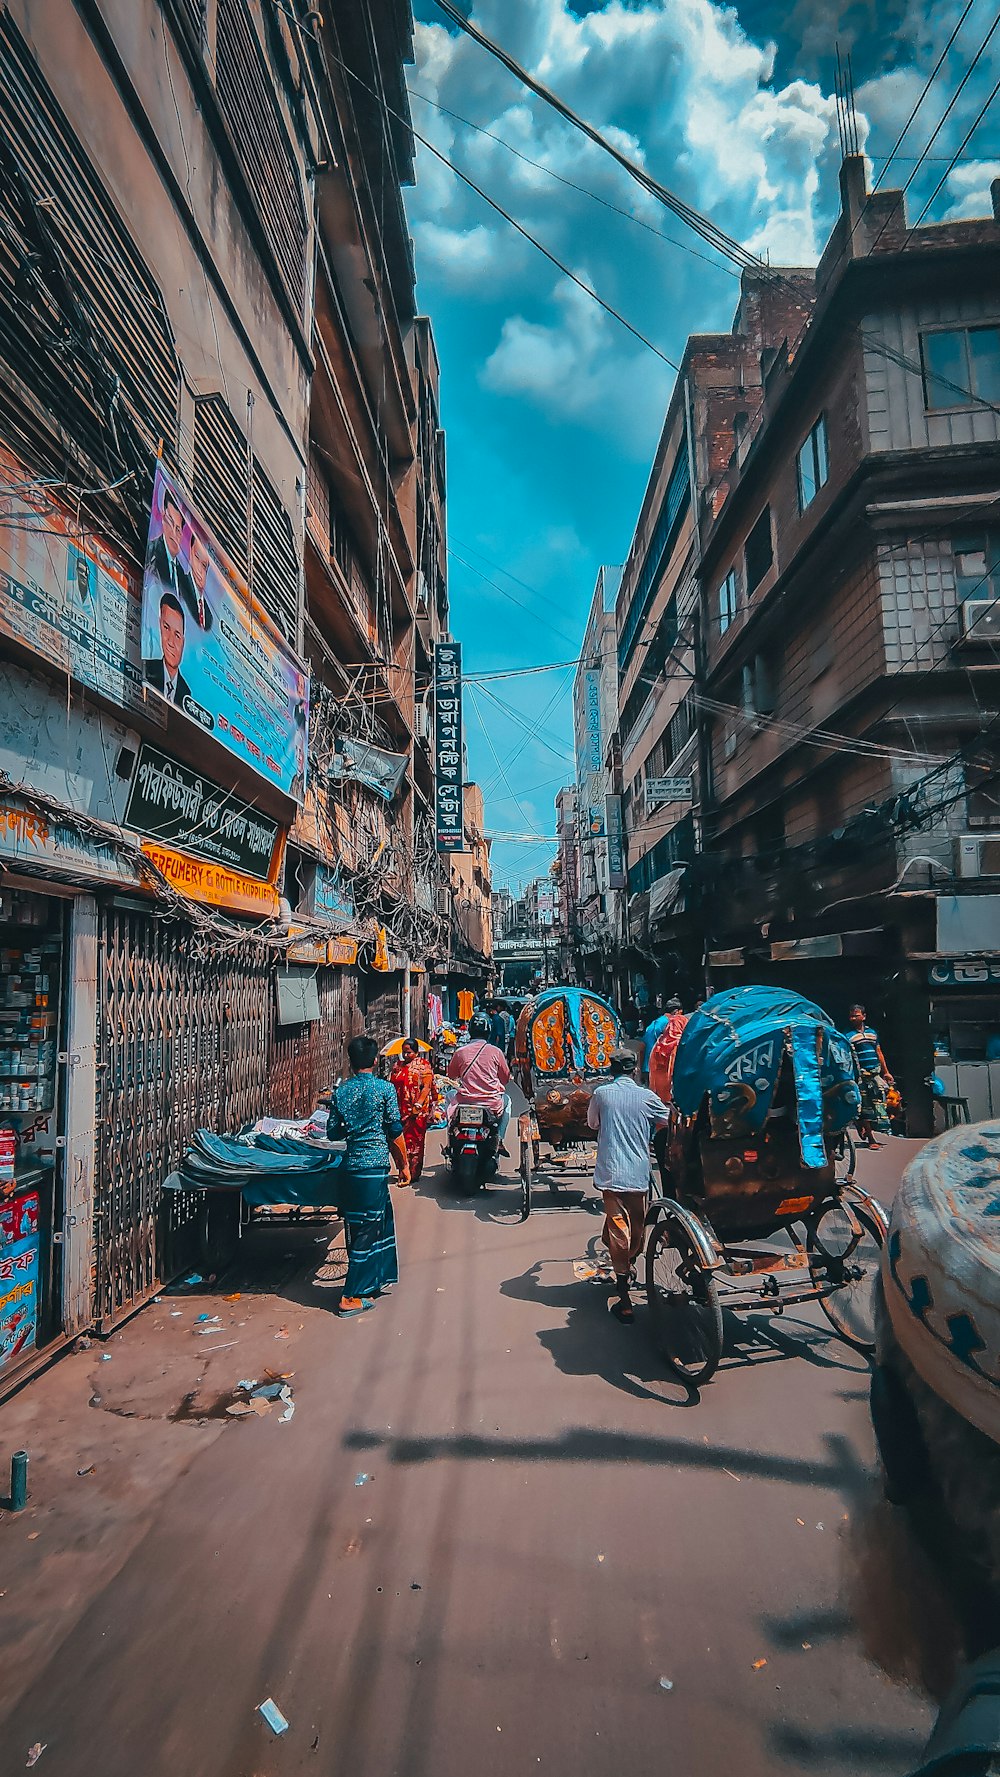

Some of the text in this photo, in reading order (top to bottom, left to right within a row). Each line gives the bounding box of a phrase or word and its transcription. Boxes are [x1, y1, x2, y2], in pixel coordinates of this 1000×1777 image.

[31, 599, 83, 642] গৌতম
[86, 635, 123, 668] কুমার
[438, 784, 460, 827] সেন্টার
[215, 872, 241, 896] BOTTLE
